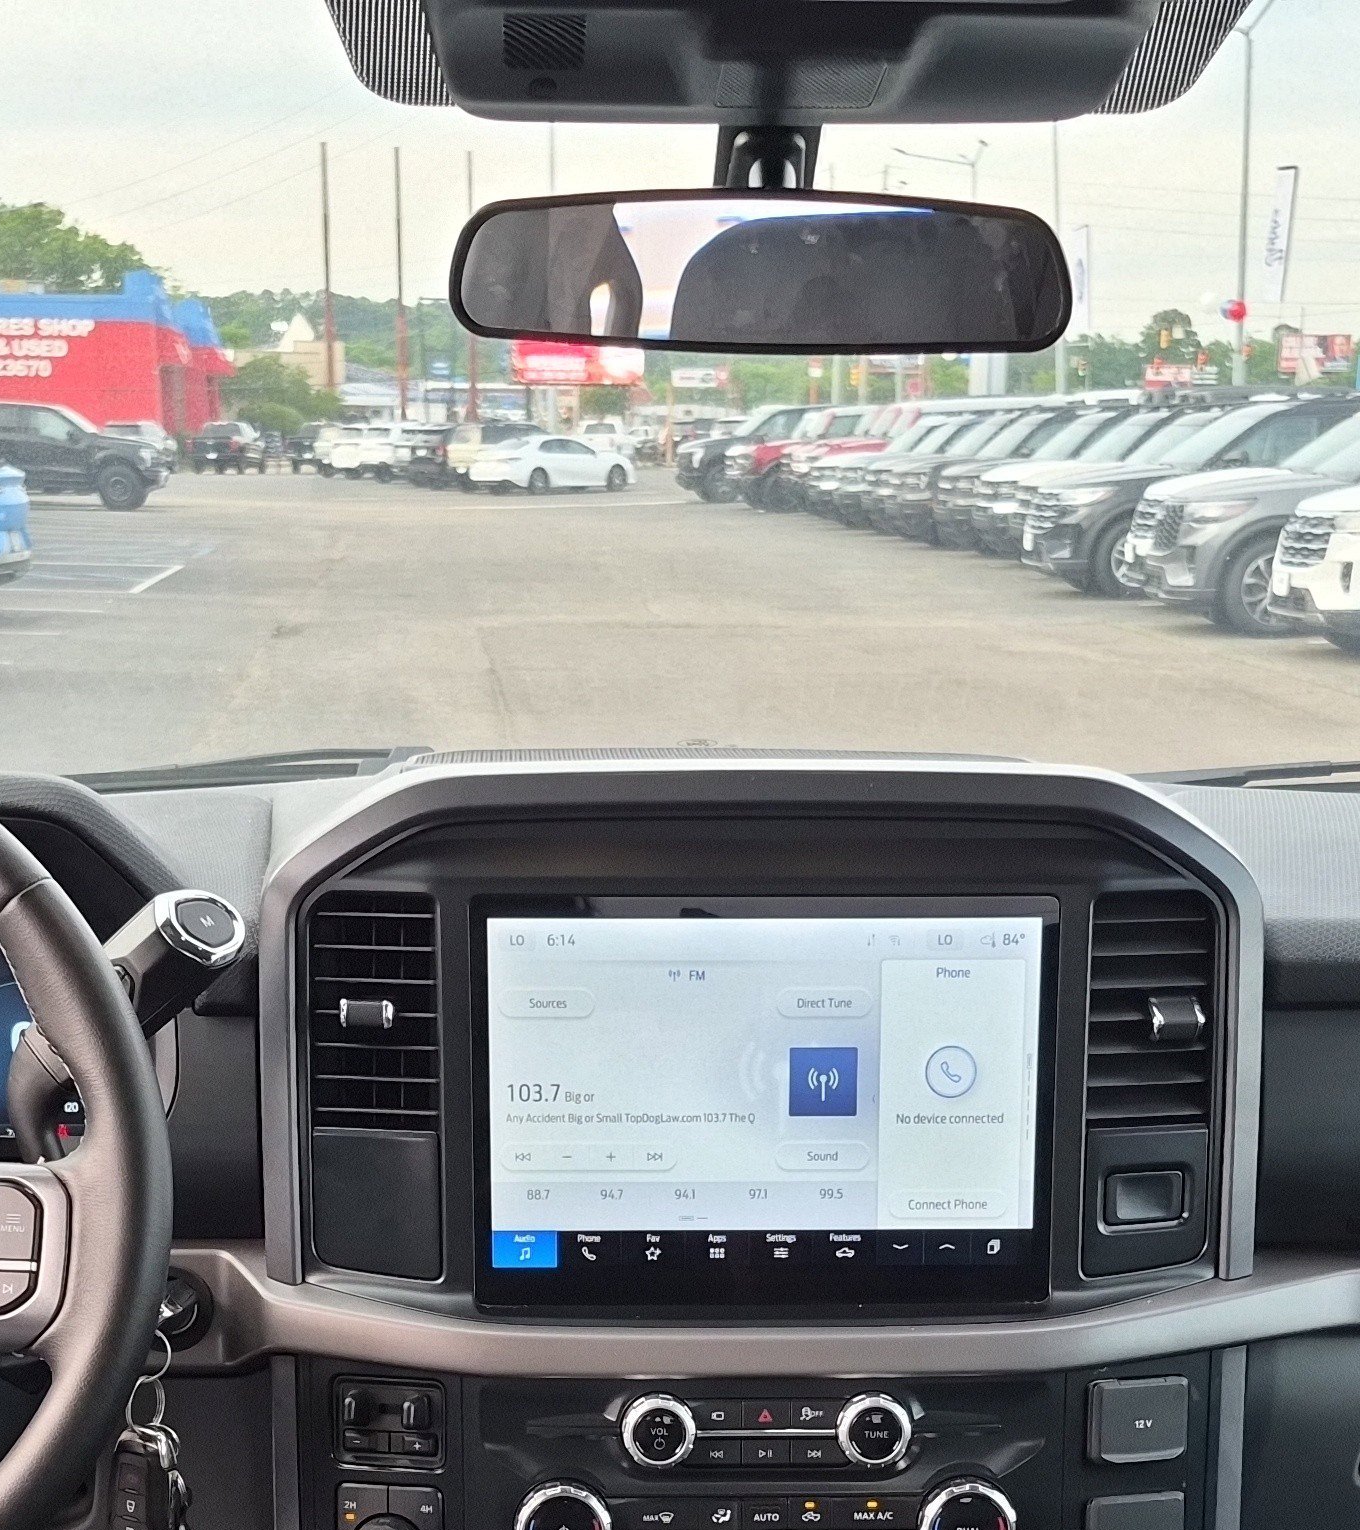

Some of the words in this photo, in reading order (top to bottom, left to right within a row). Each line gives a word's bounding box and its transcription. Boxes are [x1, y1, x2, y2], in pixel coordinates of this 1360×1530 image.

[36, 318, 96, 337] SHOP
[11, 338, 68, 357] USED
[510, 935, 525, 946] LO
[547, 934, 576, 947] 6:14
[937, 934, 953, 946] LO
[689, 970, 706, 981] FM
[936, 967, 971, 979] Phone
[529, 998, 567, 1009] Sources
[797, 998, 825, 1009] Direct
[828, 998, 852, 1009] Tune
[507, 1083, 561, 1102] 103.7
[565, 1091, 581, 1105] Big
[583, 1093, 595, 1102] or
[506, 1113, 524, 1124] Any
[526, 1113, 565, 1123] Accident
[568, 1113, 583, 1125] Big
[584, 1115, 594, 1123] or
[596, 1113, 623, 1123] Small
[625, 1113, 701, 1125] TopDogLaw.com
[703, 1113, 727, 1123] 103.7
[728, 1113, 746, 1123] The
[748, 1113, 756, 1124] Q
[896, 1113, 911, 1124] No
[913, 1113, 947, 1124] device
[949, 1113, 1004, 1124] connected
[806, 1151, 839, 1162] Sound
[527, 1189, 550, 1200] 88.7
[600, 1189, 623, 1200] 94.7
[675, 1189, 696, 1200] 94.1
[749, 1188, 768, 1199] 97.1
[819, 1188, 843, 1199] 99.5
[908, 1199, 951, 1211] Connect
[954, 1199, 988, 1210] Phone
[0, 1225, 25, 1233] MENU
[513, 1234, 536, 1243] Audio
[577, 1233, 602, 1243] Phone
[646, 1233, 660, 1243] Fav
[707, 1233, 727, 1243] Apps
[766, 1233, 797, 1244] Settings
[829, 1233, 861, 1243] Features
[811, 1410, 823, 1419] OFF
[1134, 1420, 1145, 1429] 12
[650, 1427, 669, 1437] VOL
[864, 1430, 890, 1439] TUNE
[343, 1500, 357, 1510] 2H
[420, 1504, 433, 1514] 4H
[753, 1513, 780, 1522] AUTO
[853, 1512, 875, 1521] MAX
[876, 1511, 894, 1521] A/C
